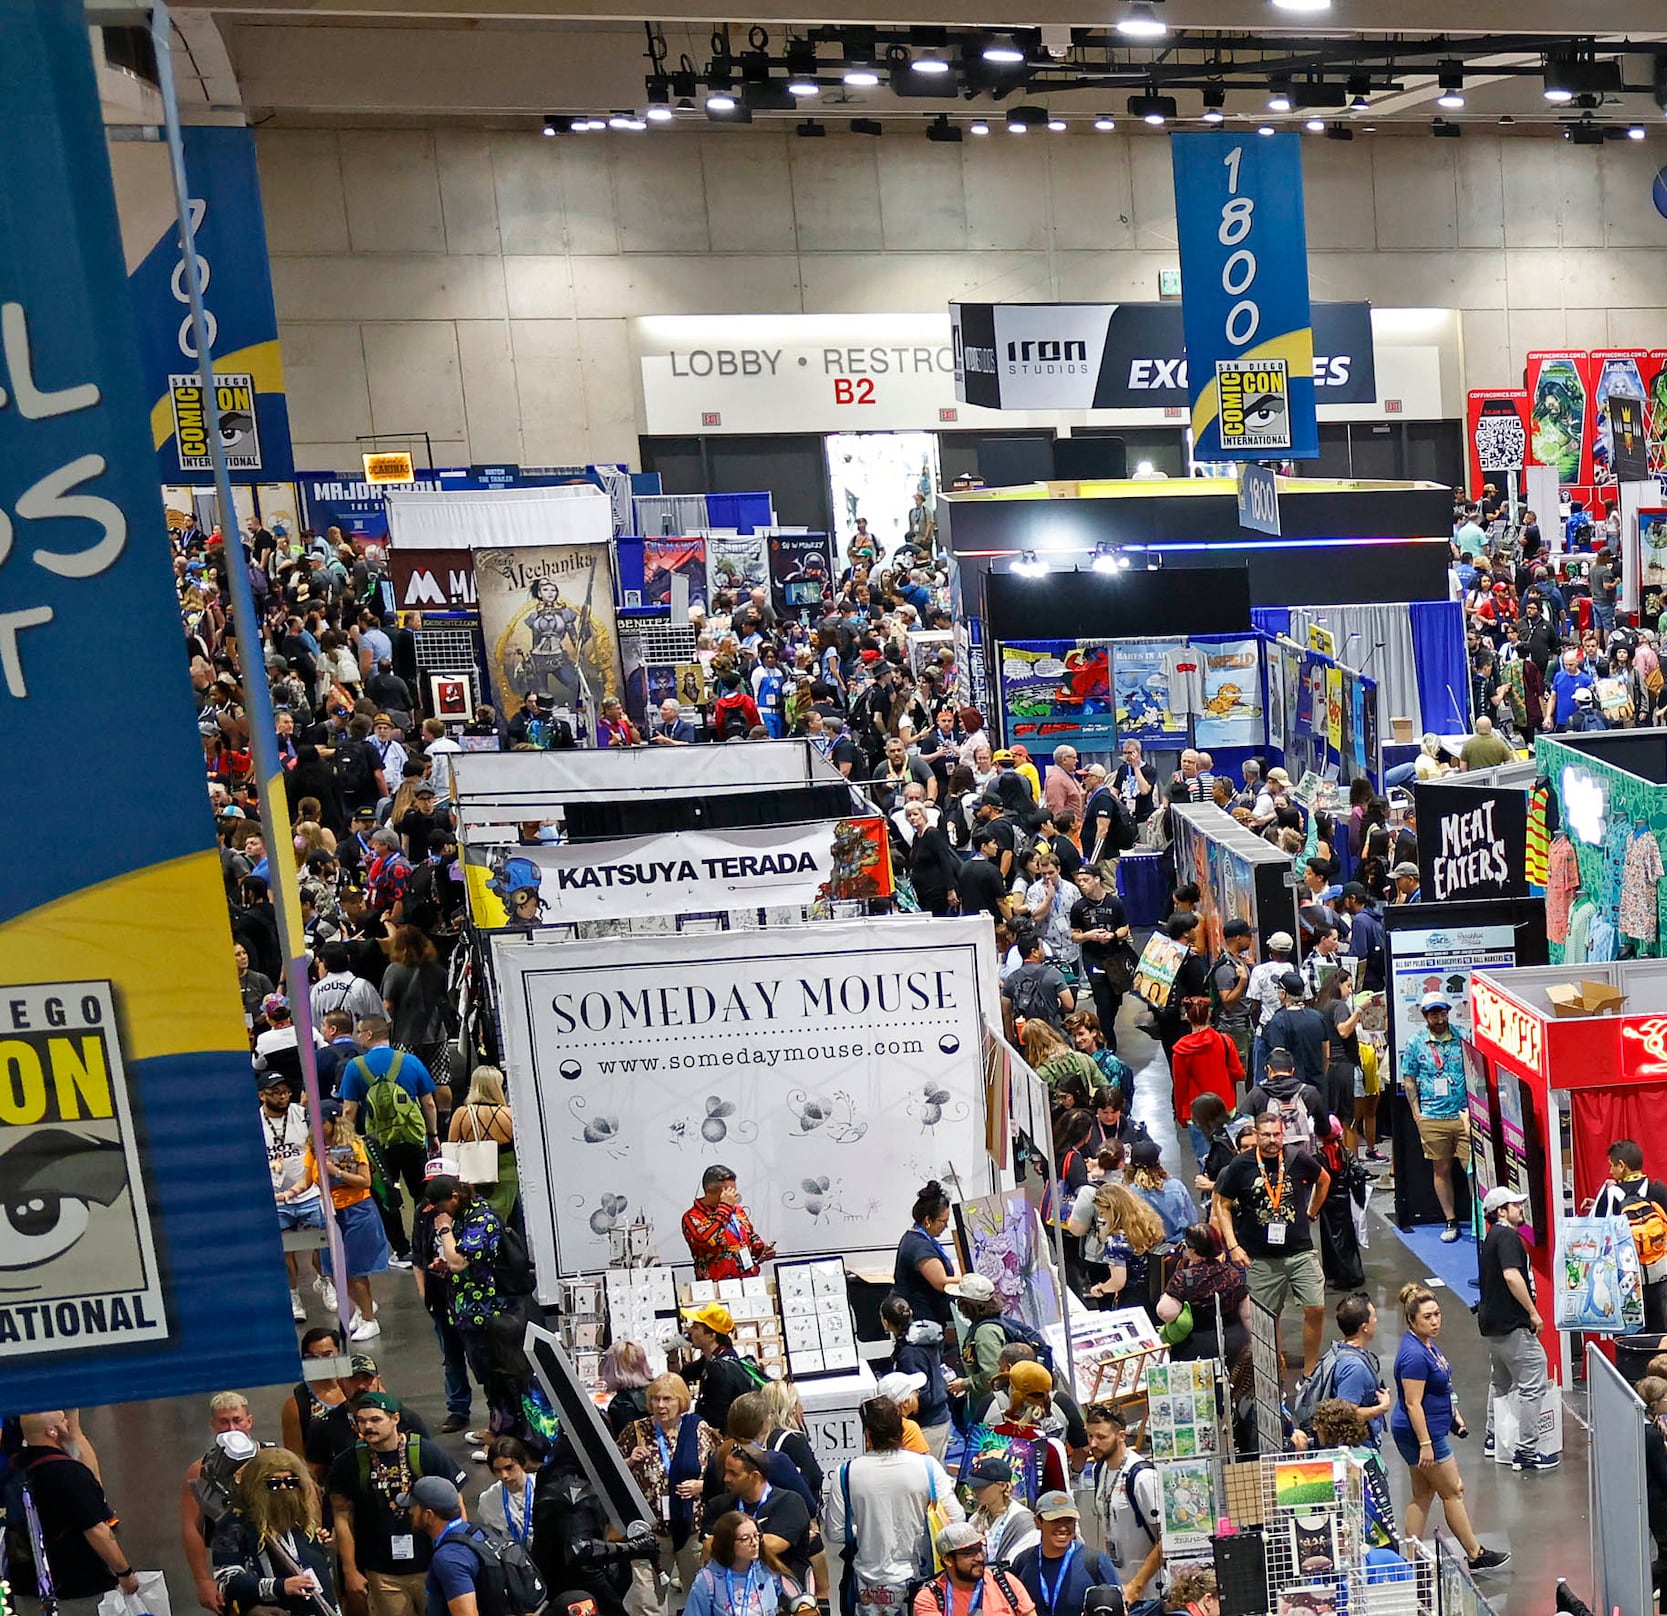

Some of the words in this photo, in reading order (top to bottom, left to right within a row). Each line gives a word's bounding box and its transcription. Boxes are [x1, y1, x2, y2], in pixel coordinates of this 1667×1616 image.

[1217, 146, 1260, 345] 1800
[671, 349, 783, 377] LOBBY
[1008, 363, 1088, 374] STUDIOS
[1218, 363, 1242, 371] SAN
[1249, 361, 1284, 370] DIEGO
[1242, 370, 1284, 394] CON
[835, 378, 877, 404] B2
[1222, 372, 1245, 436] COMIC
[176, 388, 206, 456] COMIC
[1222, 436, 1288, 446] INTERNATIONAL
[1248, 482, 1275, 521] 1800
[508, 553, 593, 589] Mechanika
[1441, 800, 1494, 853] MEAT
[557, 860, 699, 890] KATSUYA
[702, 851, 817, 879] TERADA
[1434, 847, 1508, 899] EATERS
[551, 980, 781, 1034] SOMEDAY
[800, 970, 957, 1017] MOUSE
[598, 1037, 923, 1075] www.somedaymouse.com
